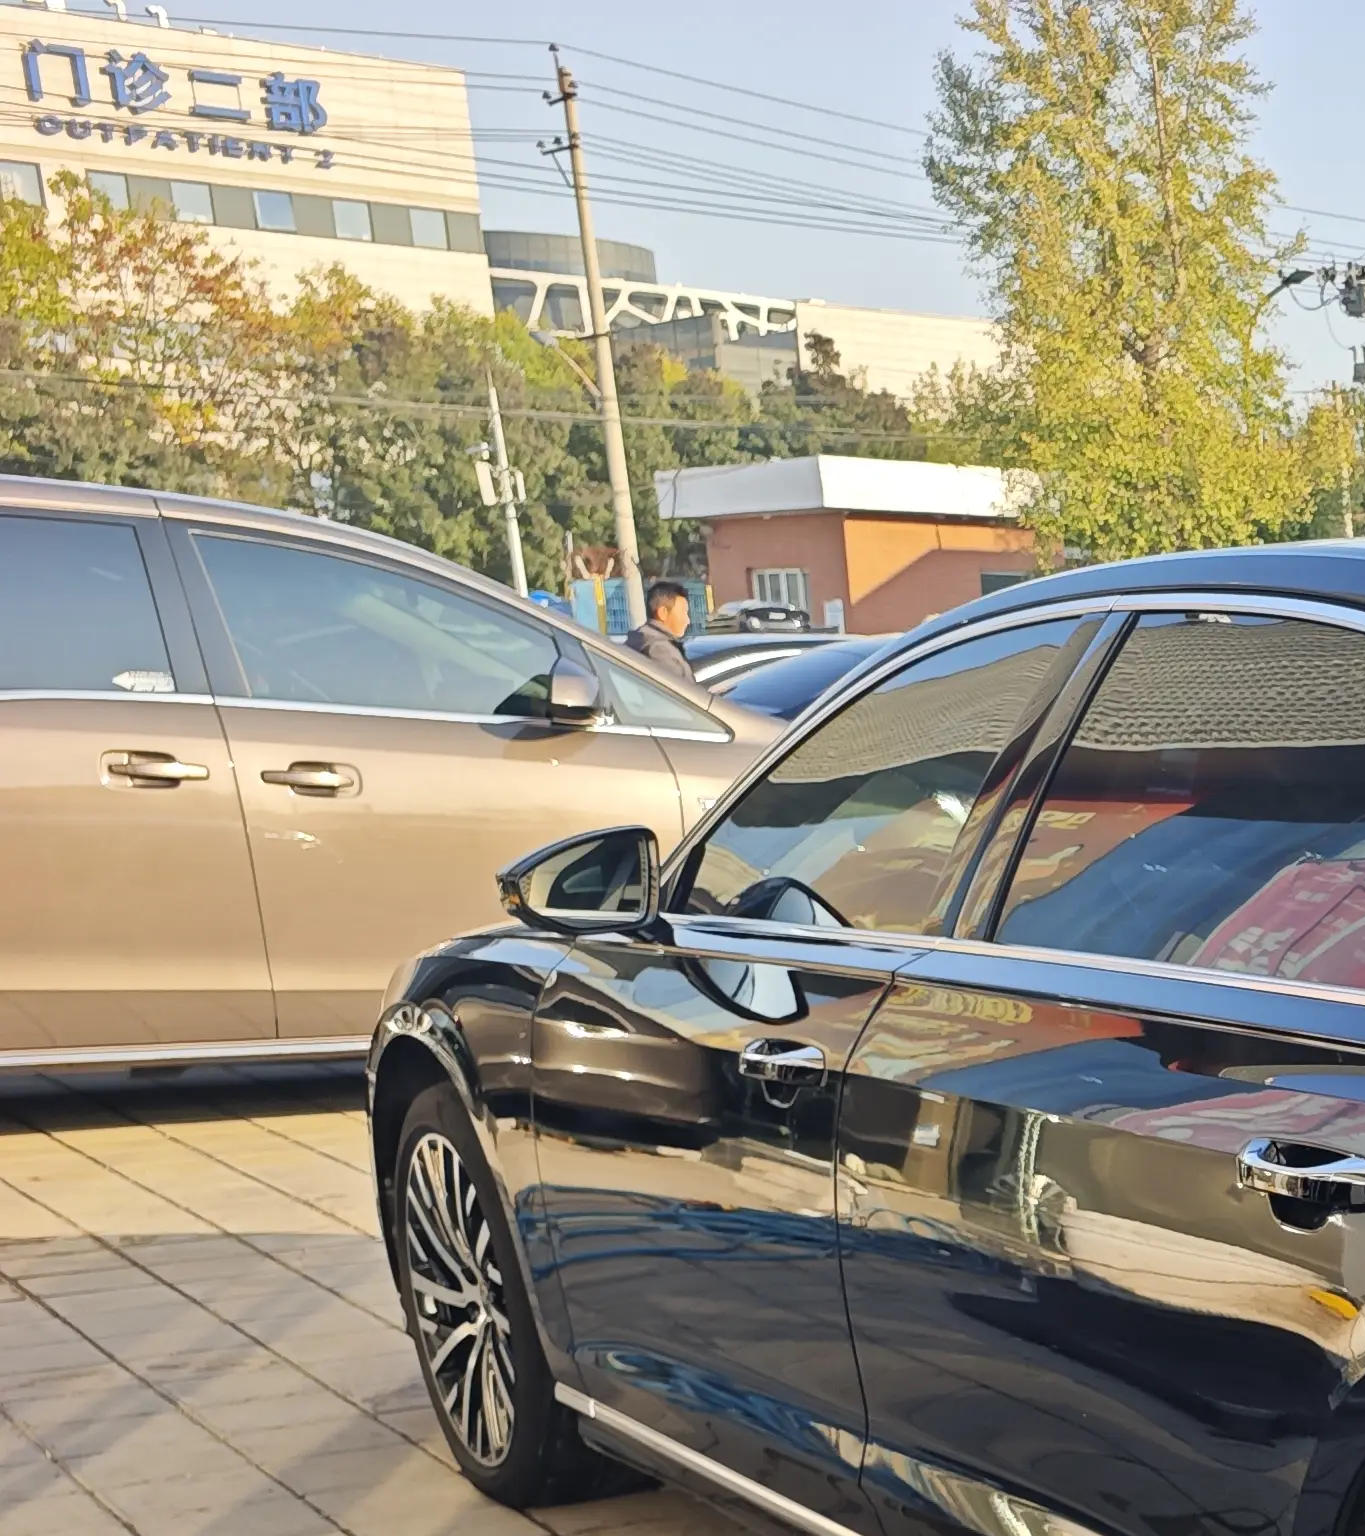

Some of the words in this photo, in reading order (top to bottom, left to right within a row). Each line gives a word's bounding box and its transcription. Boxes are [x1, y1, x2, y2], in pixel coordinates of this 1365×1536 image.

[20, 38, 328, 135] 门诊二部
[33, 113, 294, 165] OUTPATIENT
[314, 149, 334, 169] 2
